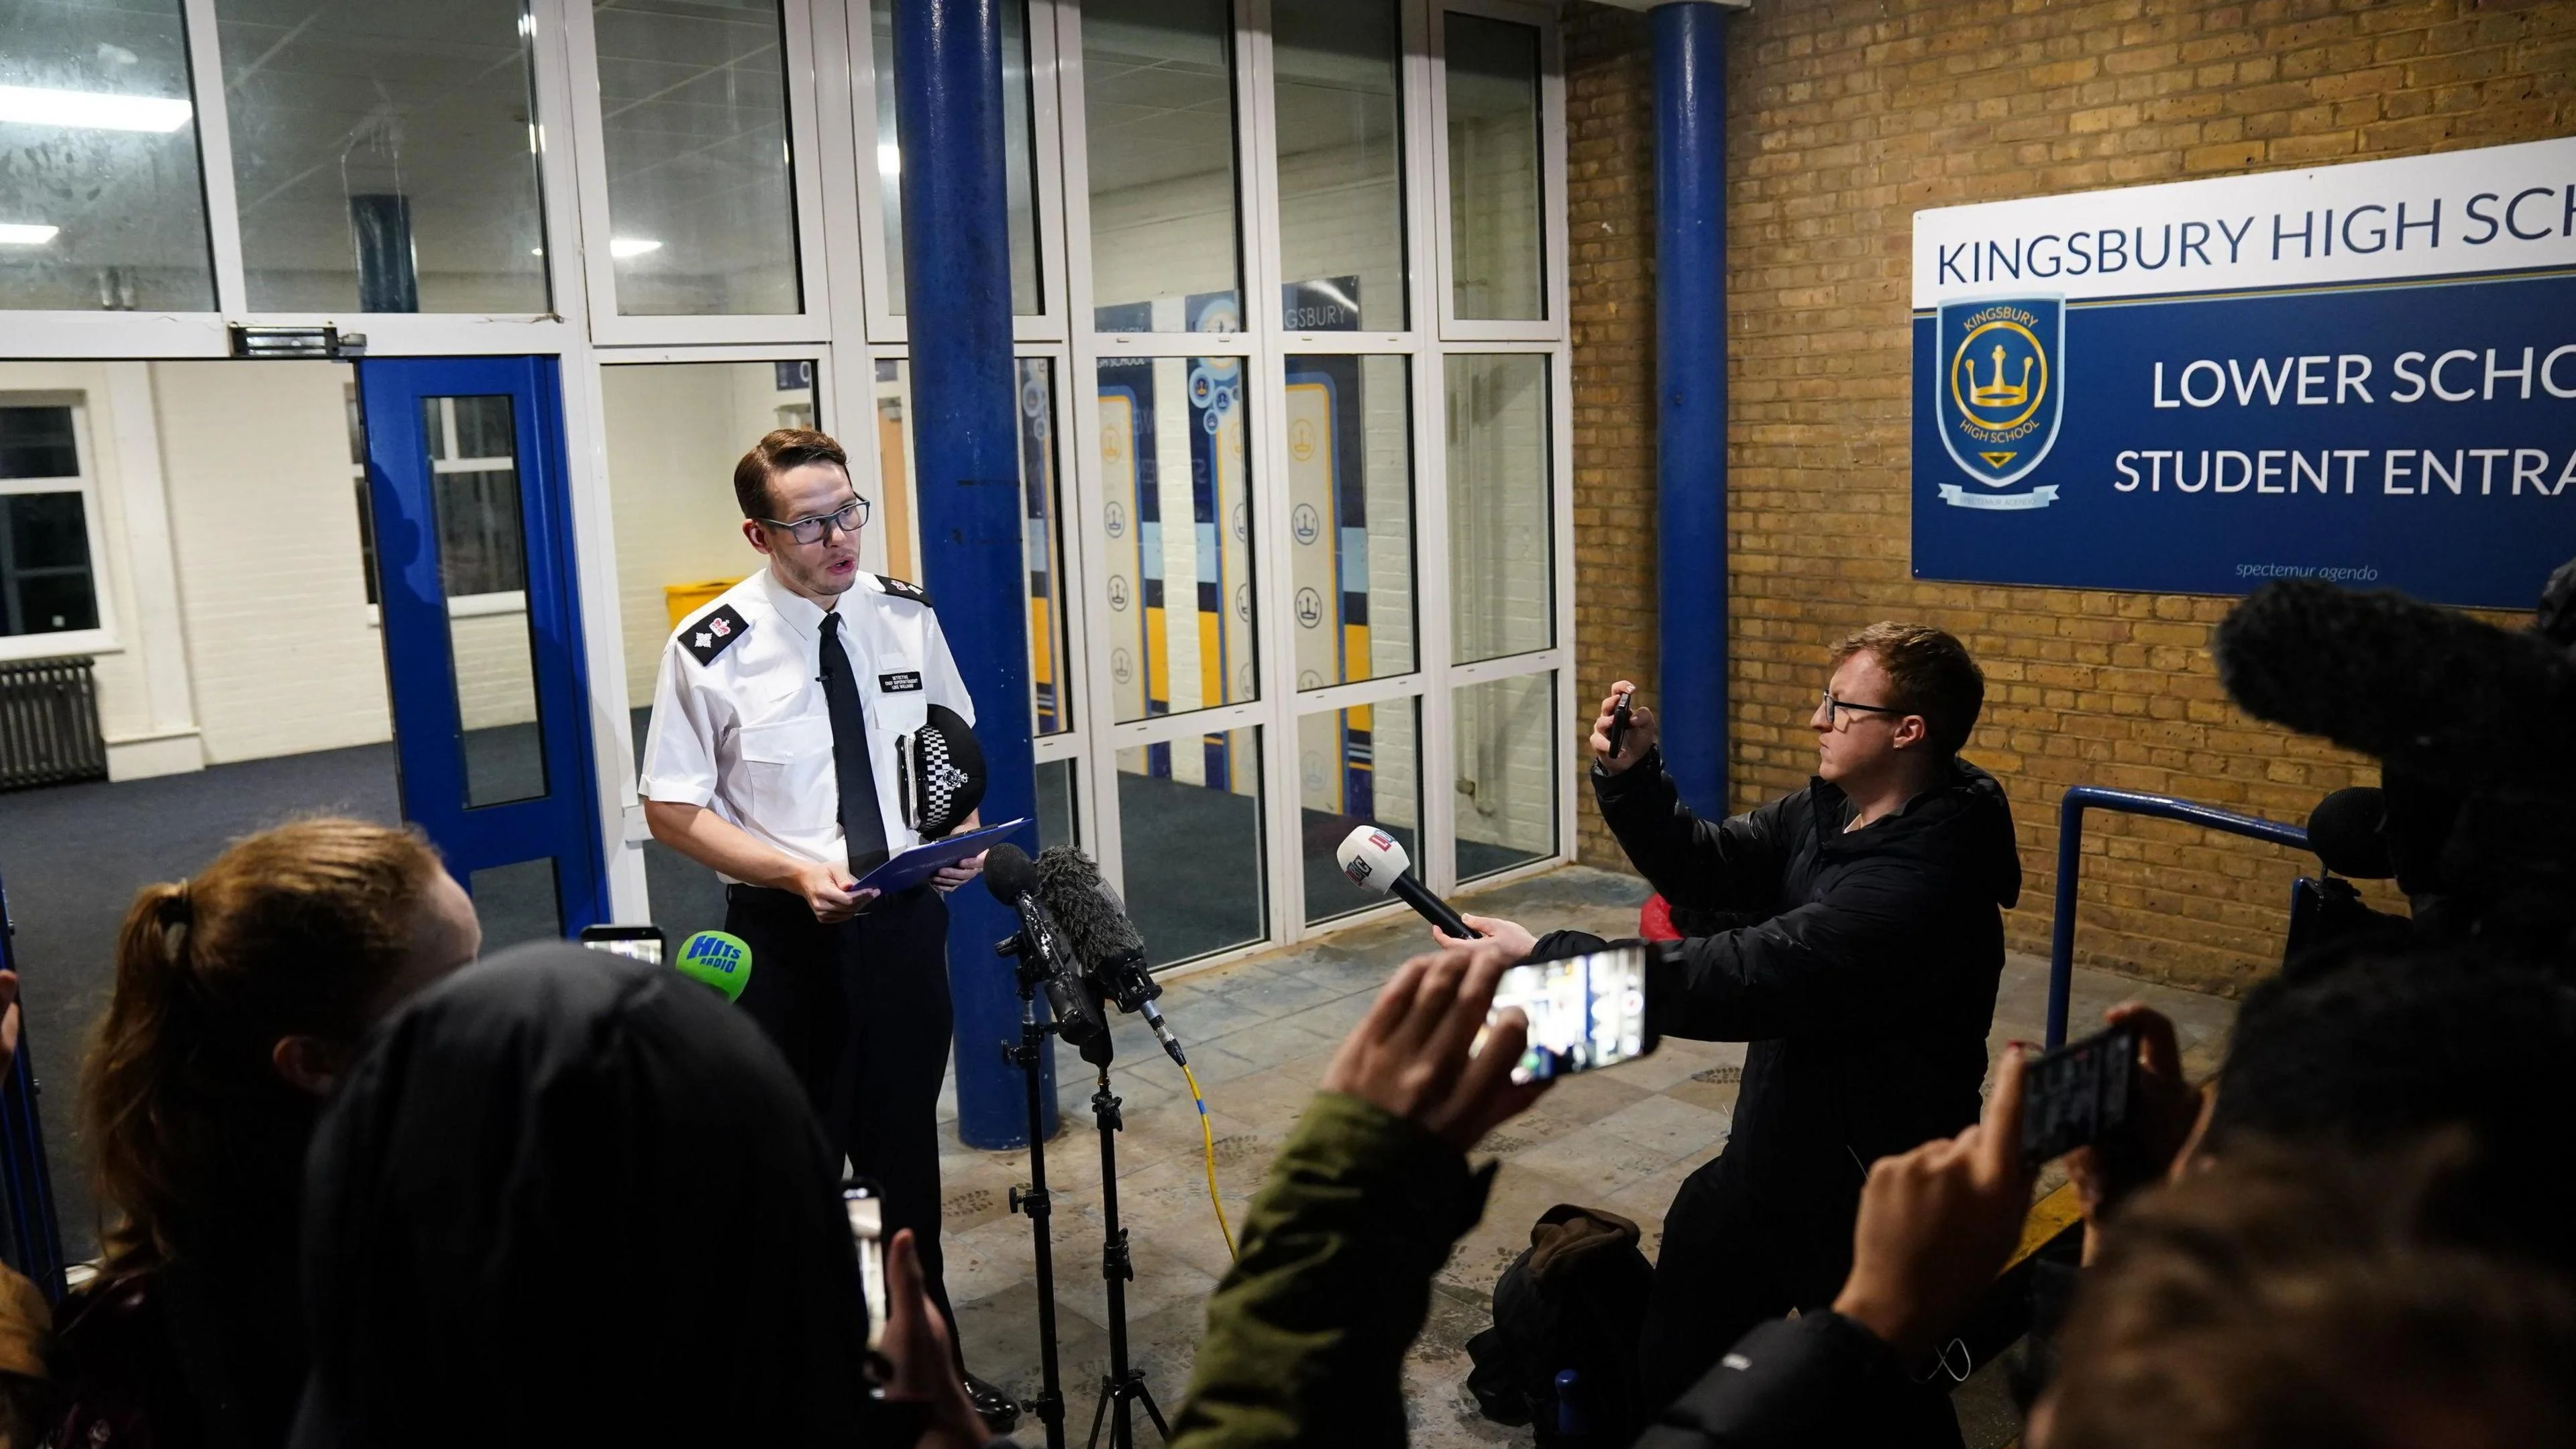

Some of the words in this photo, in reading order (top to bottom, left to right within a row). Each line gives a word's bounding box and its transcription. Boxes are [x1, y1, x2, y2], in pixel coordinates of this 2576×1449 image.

[1939, 215, 2257, 285] KINGSBURY
[2271, 197, 2442, 262] HIGH
[1964, 306, 2039, 331] KINGSBURY
[2153, 354, 2375, 409] LOWER
[1959, 419, 1989, 442] HIGH
[1990, 419, 2040, 443] SCHOOL
[2113, 449, 2369, 494] STUDENT
[2235, 563, 2316, 578] spectemur
[2318, 565, 2379, 582] agendo
[699, 957, 737, 973] RADIO
